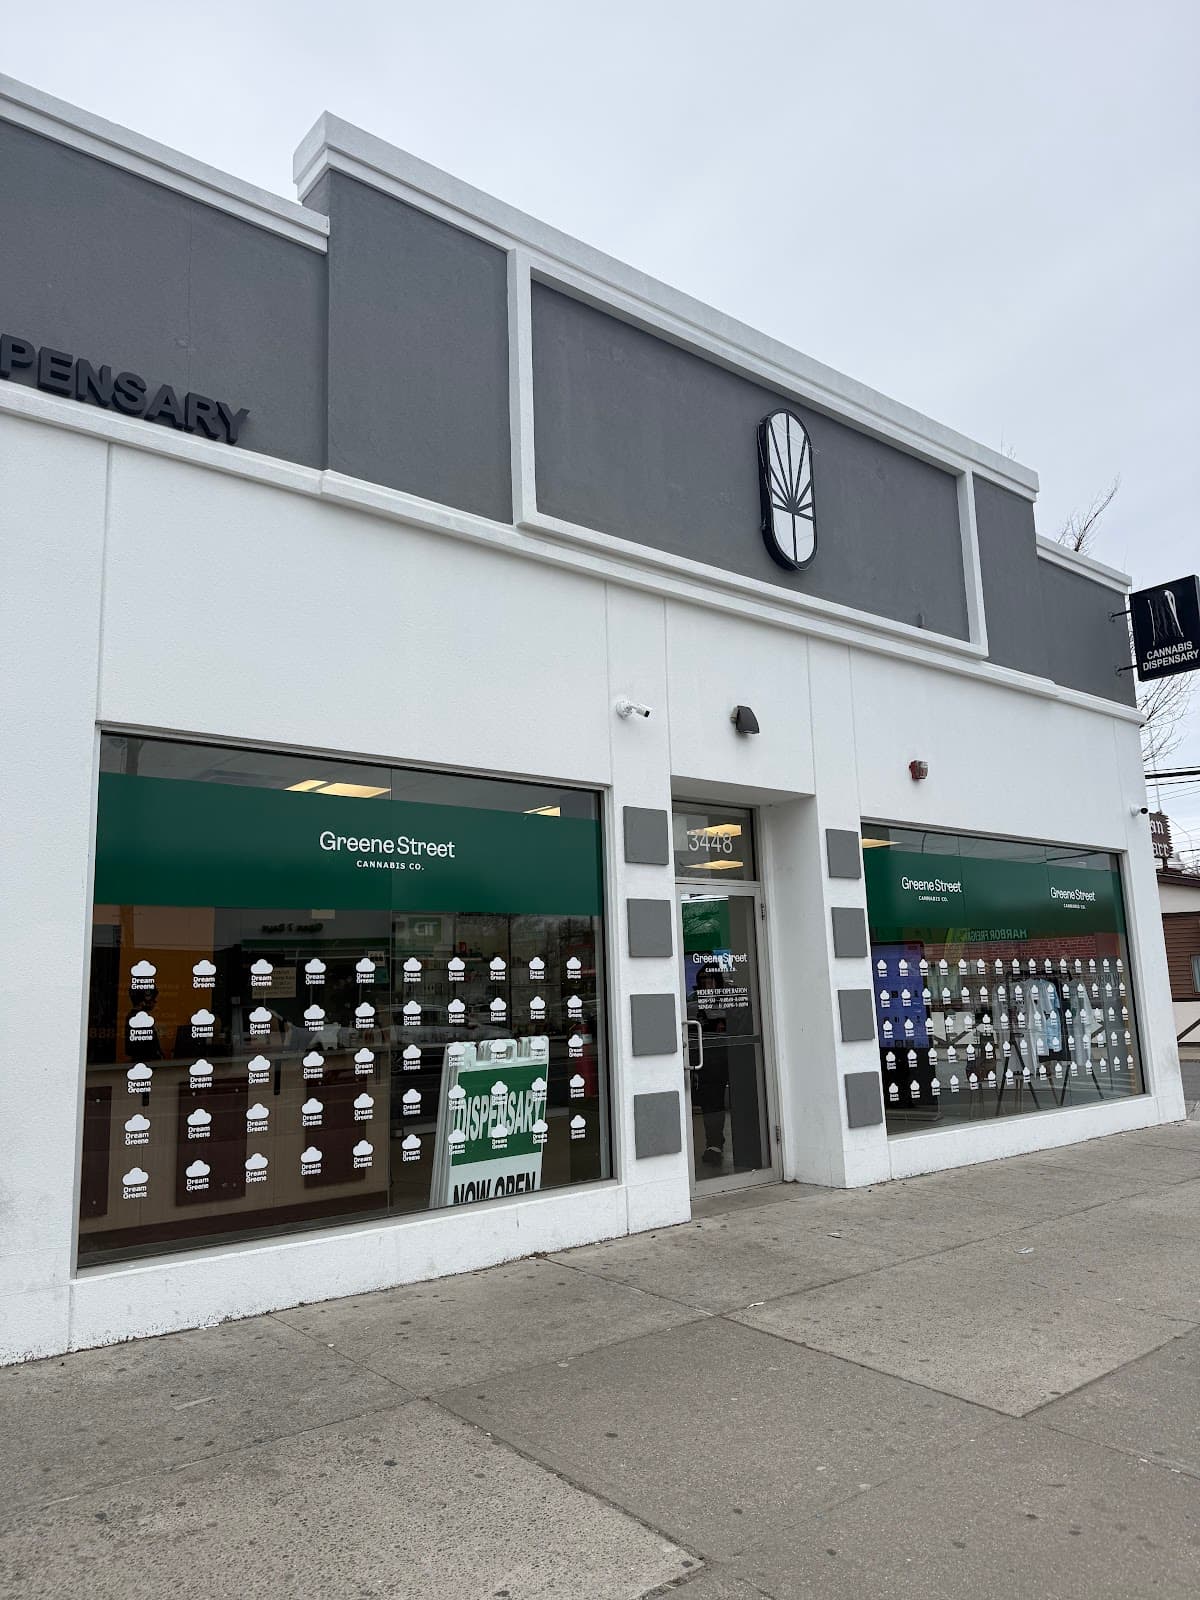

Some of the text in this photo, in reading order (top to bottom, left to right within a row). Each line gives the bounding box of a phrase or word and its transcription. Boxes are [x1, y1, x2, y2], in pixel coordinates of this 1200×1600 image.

[0, 333, 250, 445] PENSARY
[1146, 641, 1193, 660] CANNABIS
[1142, 649, 1199, 671] DISPENSARY
[689, 832, 733, 854] 3448
[356, 860, 406, 870] CANNABIS
[249, 1071, 269, 1079] Dream
[453, 1089, 544, 1142] DISPENSARY
[125, 1132, 149, 1140] Dream
[246, 1169, 267, 1178] Dream
[187, 1177, 209, 1185] Dream
[453, 1171, 536, 1205] NOW OPEN
[123, 1185, 147, 1193] Dream
